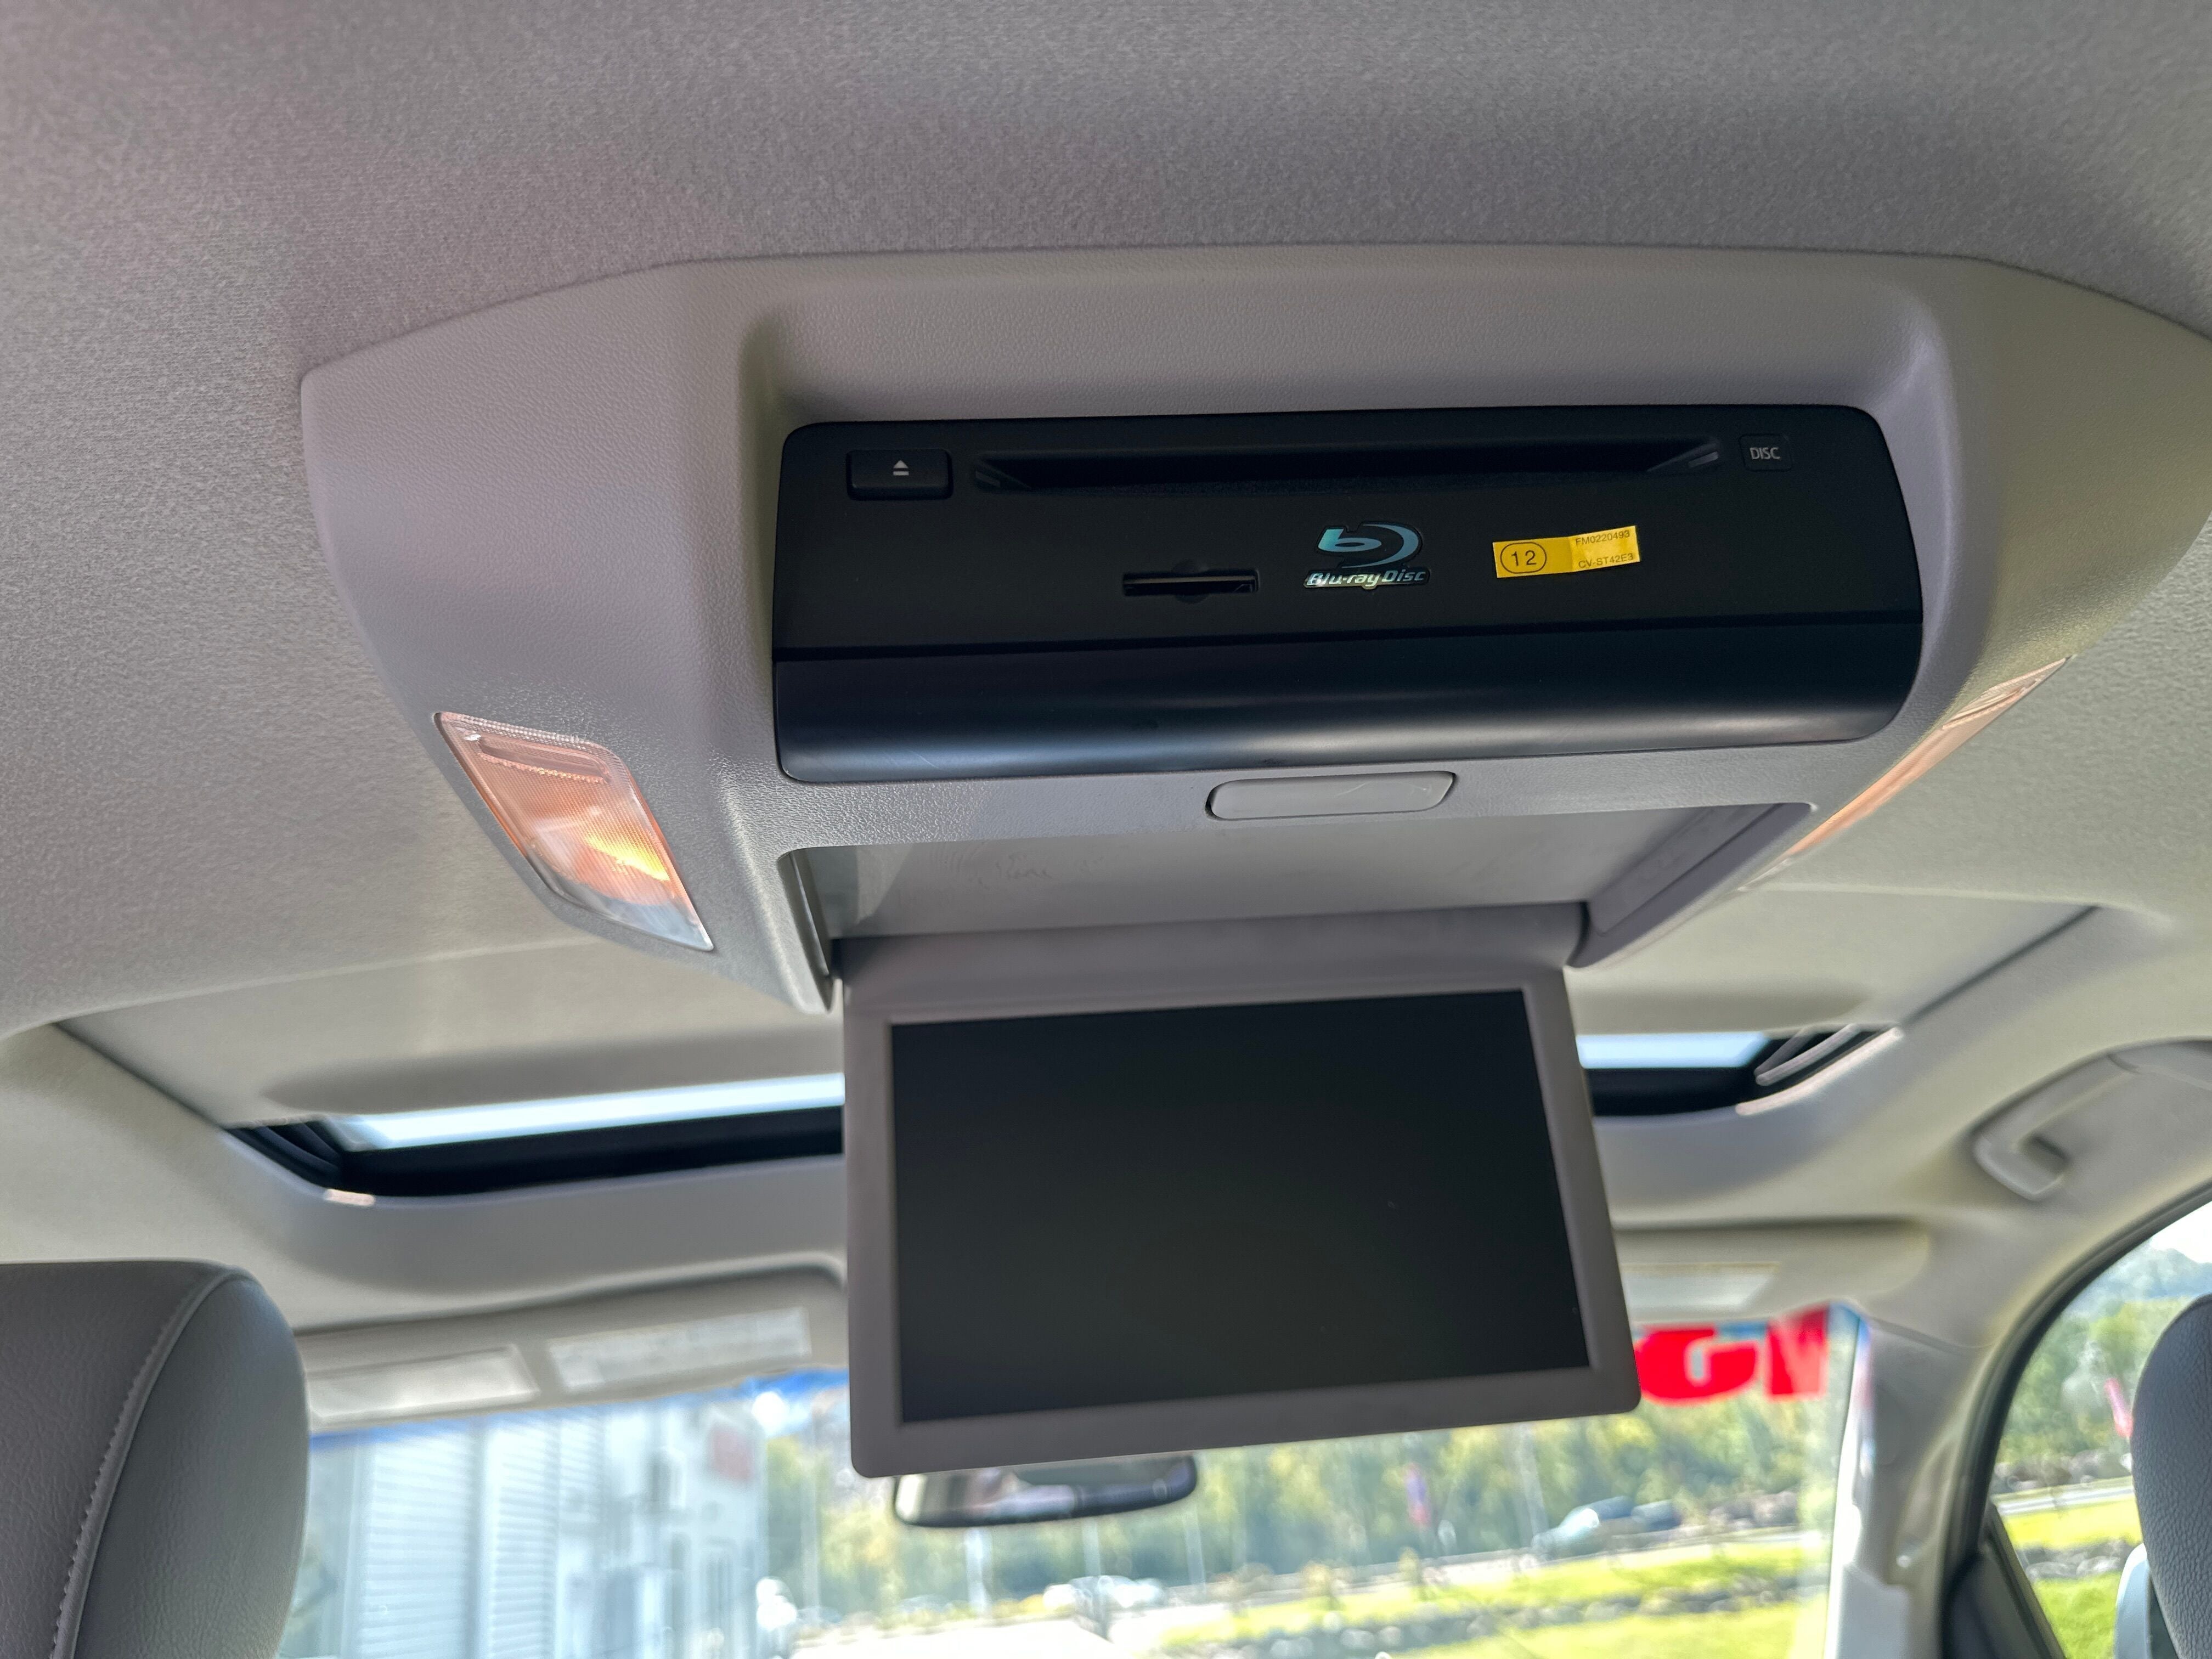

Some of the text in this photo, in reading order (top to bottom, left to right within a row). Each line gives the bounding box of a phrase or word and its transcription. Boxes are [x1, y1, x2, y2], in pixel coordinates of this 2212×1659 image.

[1750, 447, 1781, 460] DISC
[1576, 530, 1630, 546] FM0220493
[1511, 550, 1537, 567] 12
[1578, 552, 1633, 568] CV-ST42E3
[1306, 569, 1426, 586] Blu-ray Disc
